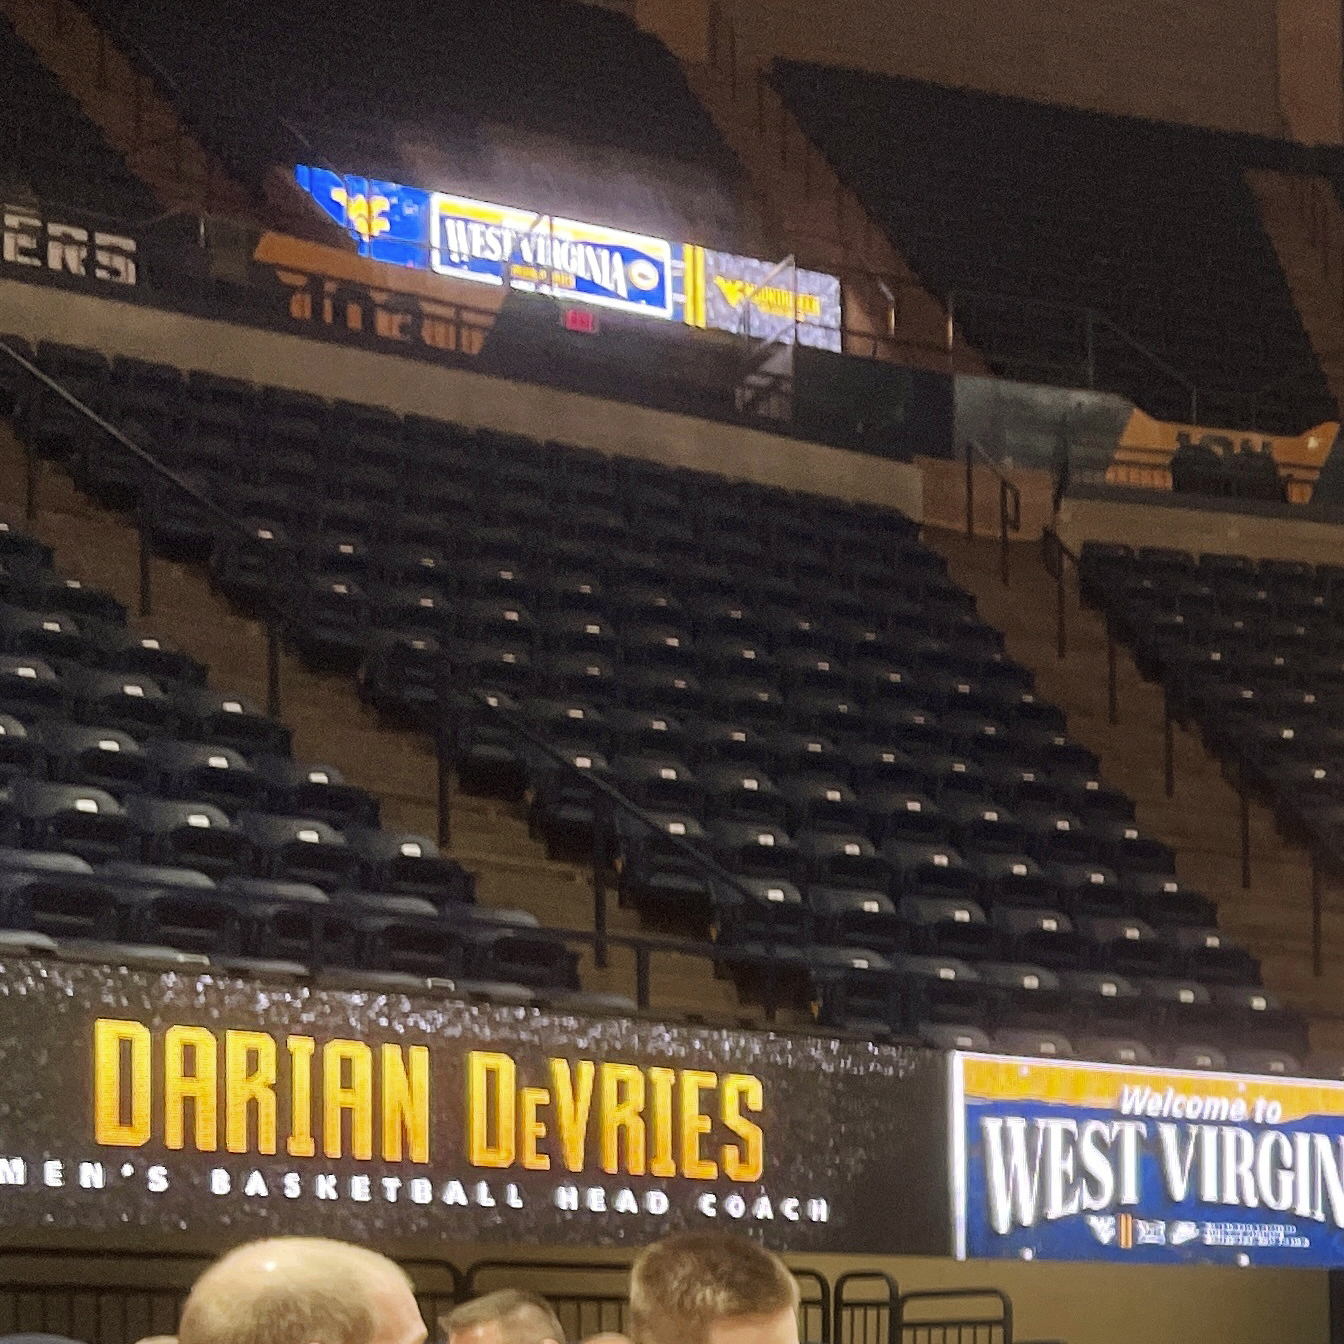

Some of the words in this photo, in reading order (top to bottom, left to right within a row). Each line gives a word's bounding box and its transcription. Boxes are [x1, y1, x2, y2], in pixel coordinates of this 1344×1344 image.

[445, 218, 517, 264] WEST
[519, 232, 628, 299] VIRGINIA
[94, 1017, 430, 1164] DARIAN
[1119, 1083, 1250, 1121] Welcome
[1254, 1094, 1282, 1125] to
[0, 1156, 170, 1193] MEN'S
[209, 1166, 525, 1210] BASKETBALL
[554, 1184, 670, 1215] HEAD
[699, 1192, 830, 1222] COACH
[980, 1115, 1148, 1236] WEST
